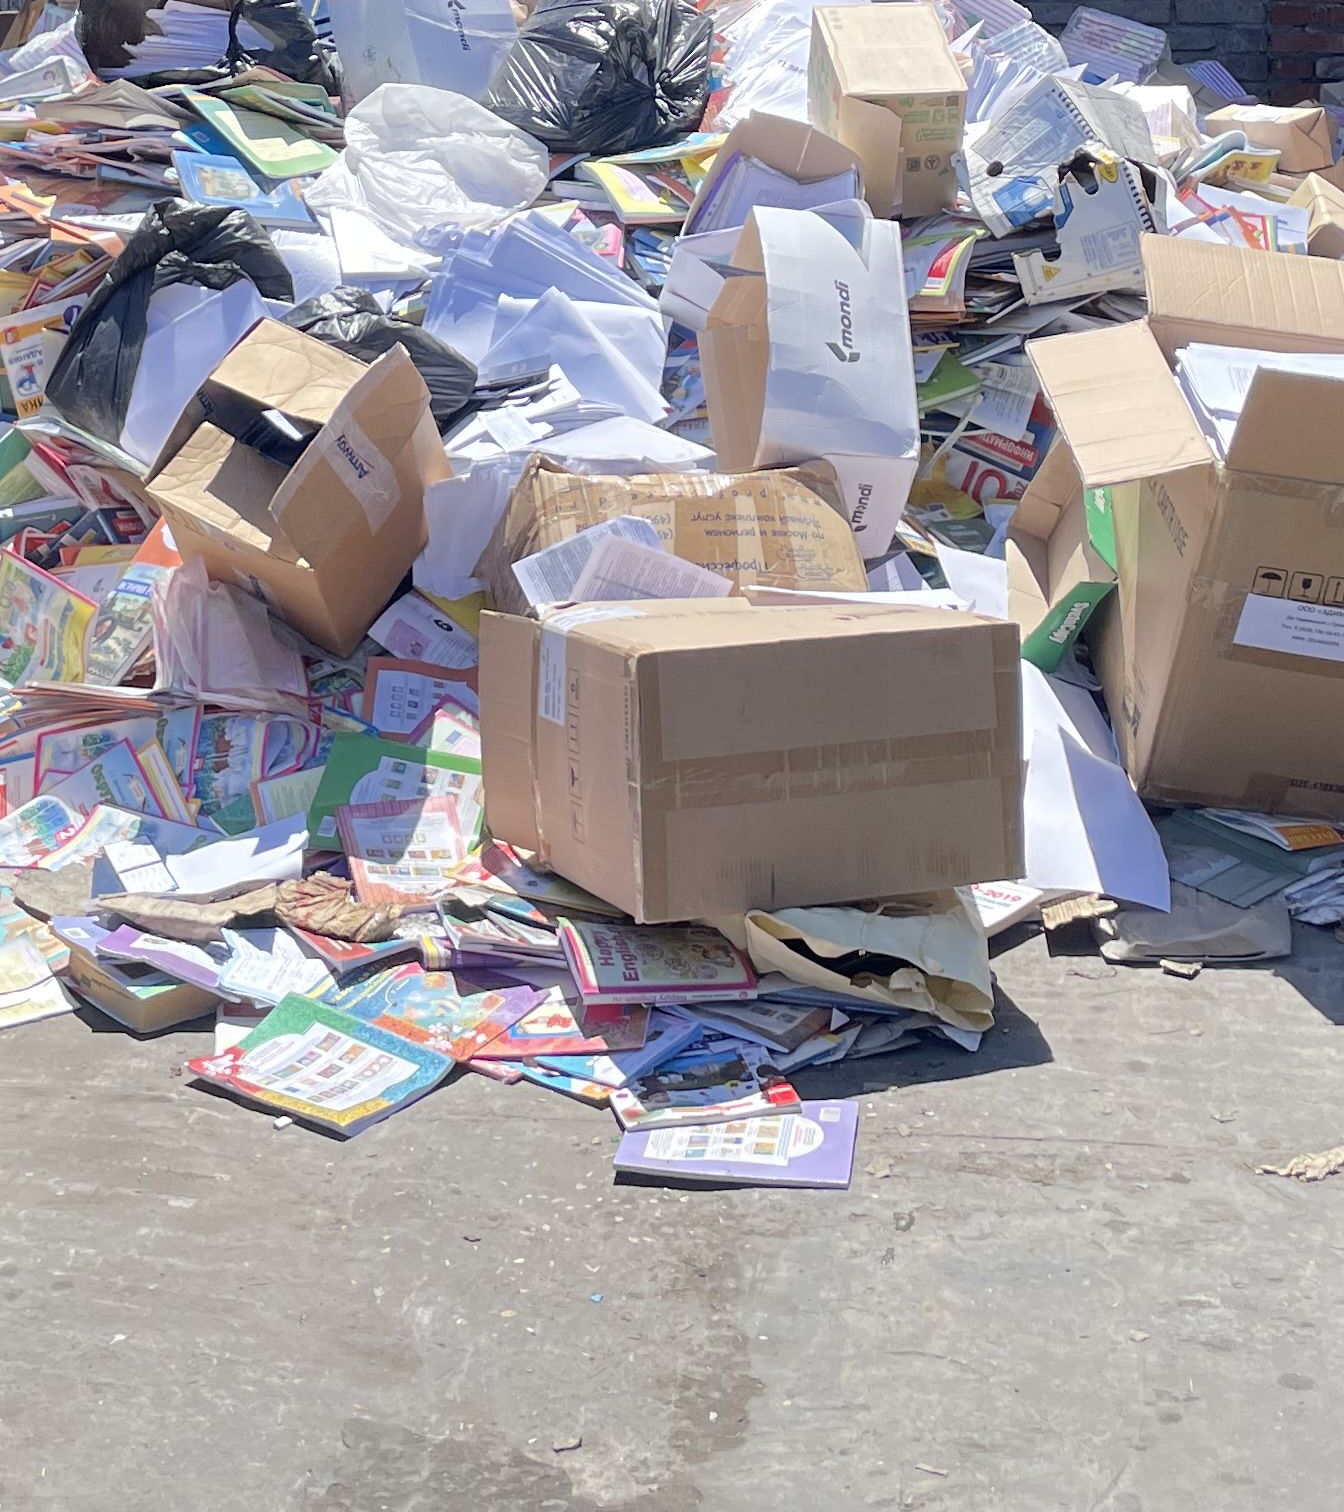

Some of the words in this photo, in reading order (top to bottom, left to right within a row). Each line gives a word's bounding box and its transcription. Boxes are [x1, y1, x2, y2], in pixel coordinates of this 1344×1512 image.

[834, 279, 853, 350] mondi
[335, 432, 370, 481] Amway
[978, 431, 1036, 462] ИНФОРМАТИ
[690, 512, 722, 522] услуг
[725, 514, 775, 523] комплекс
[852, 483, 874, 525] mondi
[704, 526, 757, 538] регионам
[592, 928, 615, 967] Happy
